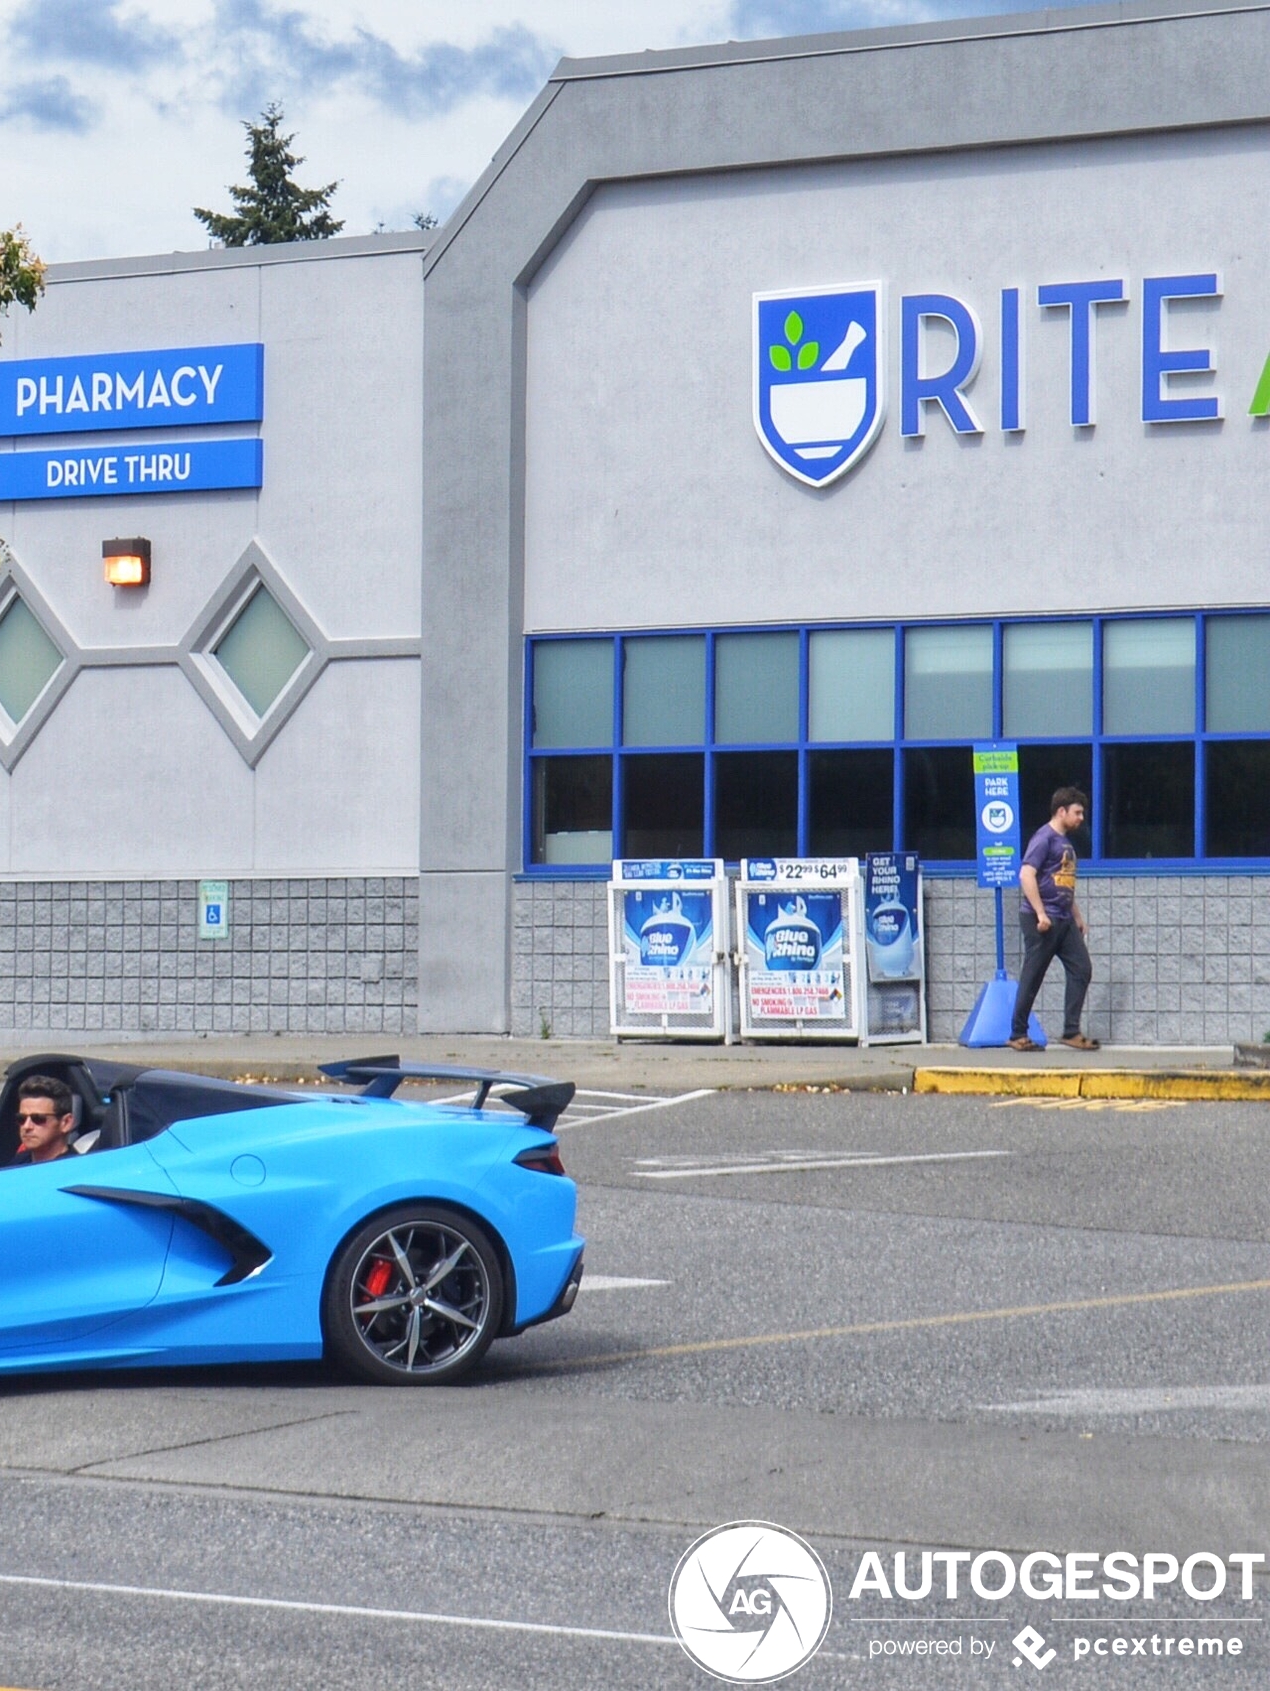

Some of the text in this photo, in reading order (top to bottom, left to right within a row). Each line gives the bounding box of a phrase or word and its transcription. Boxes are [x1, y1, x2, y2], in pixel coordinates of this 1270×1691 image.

[901, 273, 1222, 437] RITE
[16, 364, 223, 416] PHARMACY
[47, 453, 191, 487] DRIVE THRU
[985, 777, 1008, 786] PARK
[985, 786, 1008, 796] HERE
[872, 857, 890, 866] GET
[872, 866, 896, 875] YOUR
[872, 876, 900, 885] RHINO
[649, 932, 673, 944] Blue
[776, 929, 809, 943] Blue
